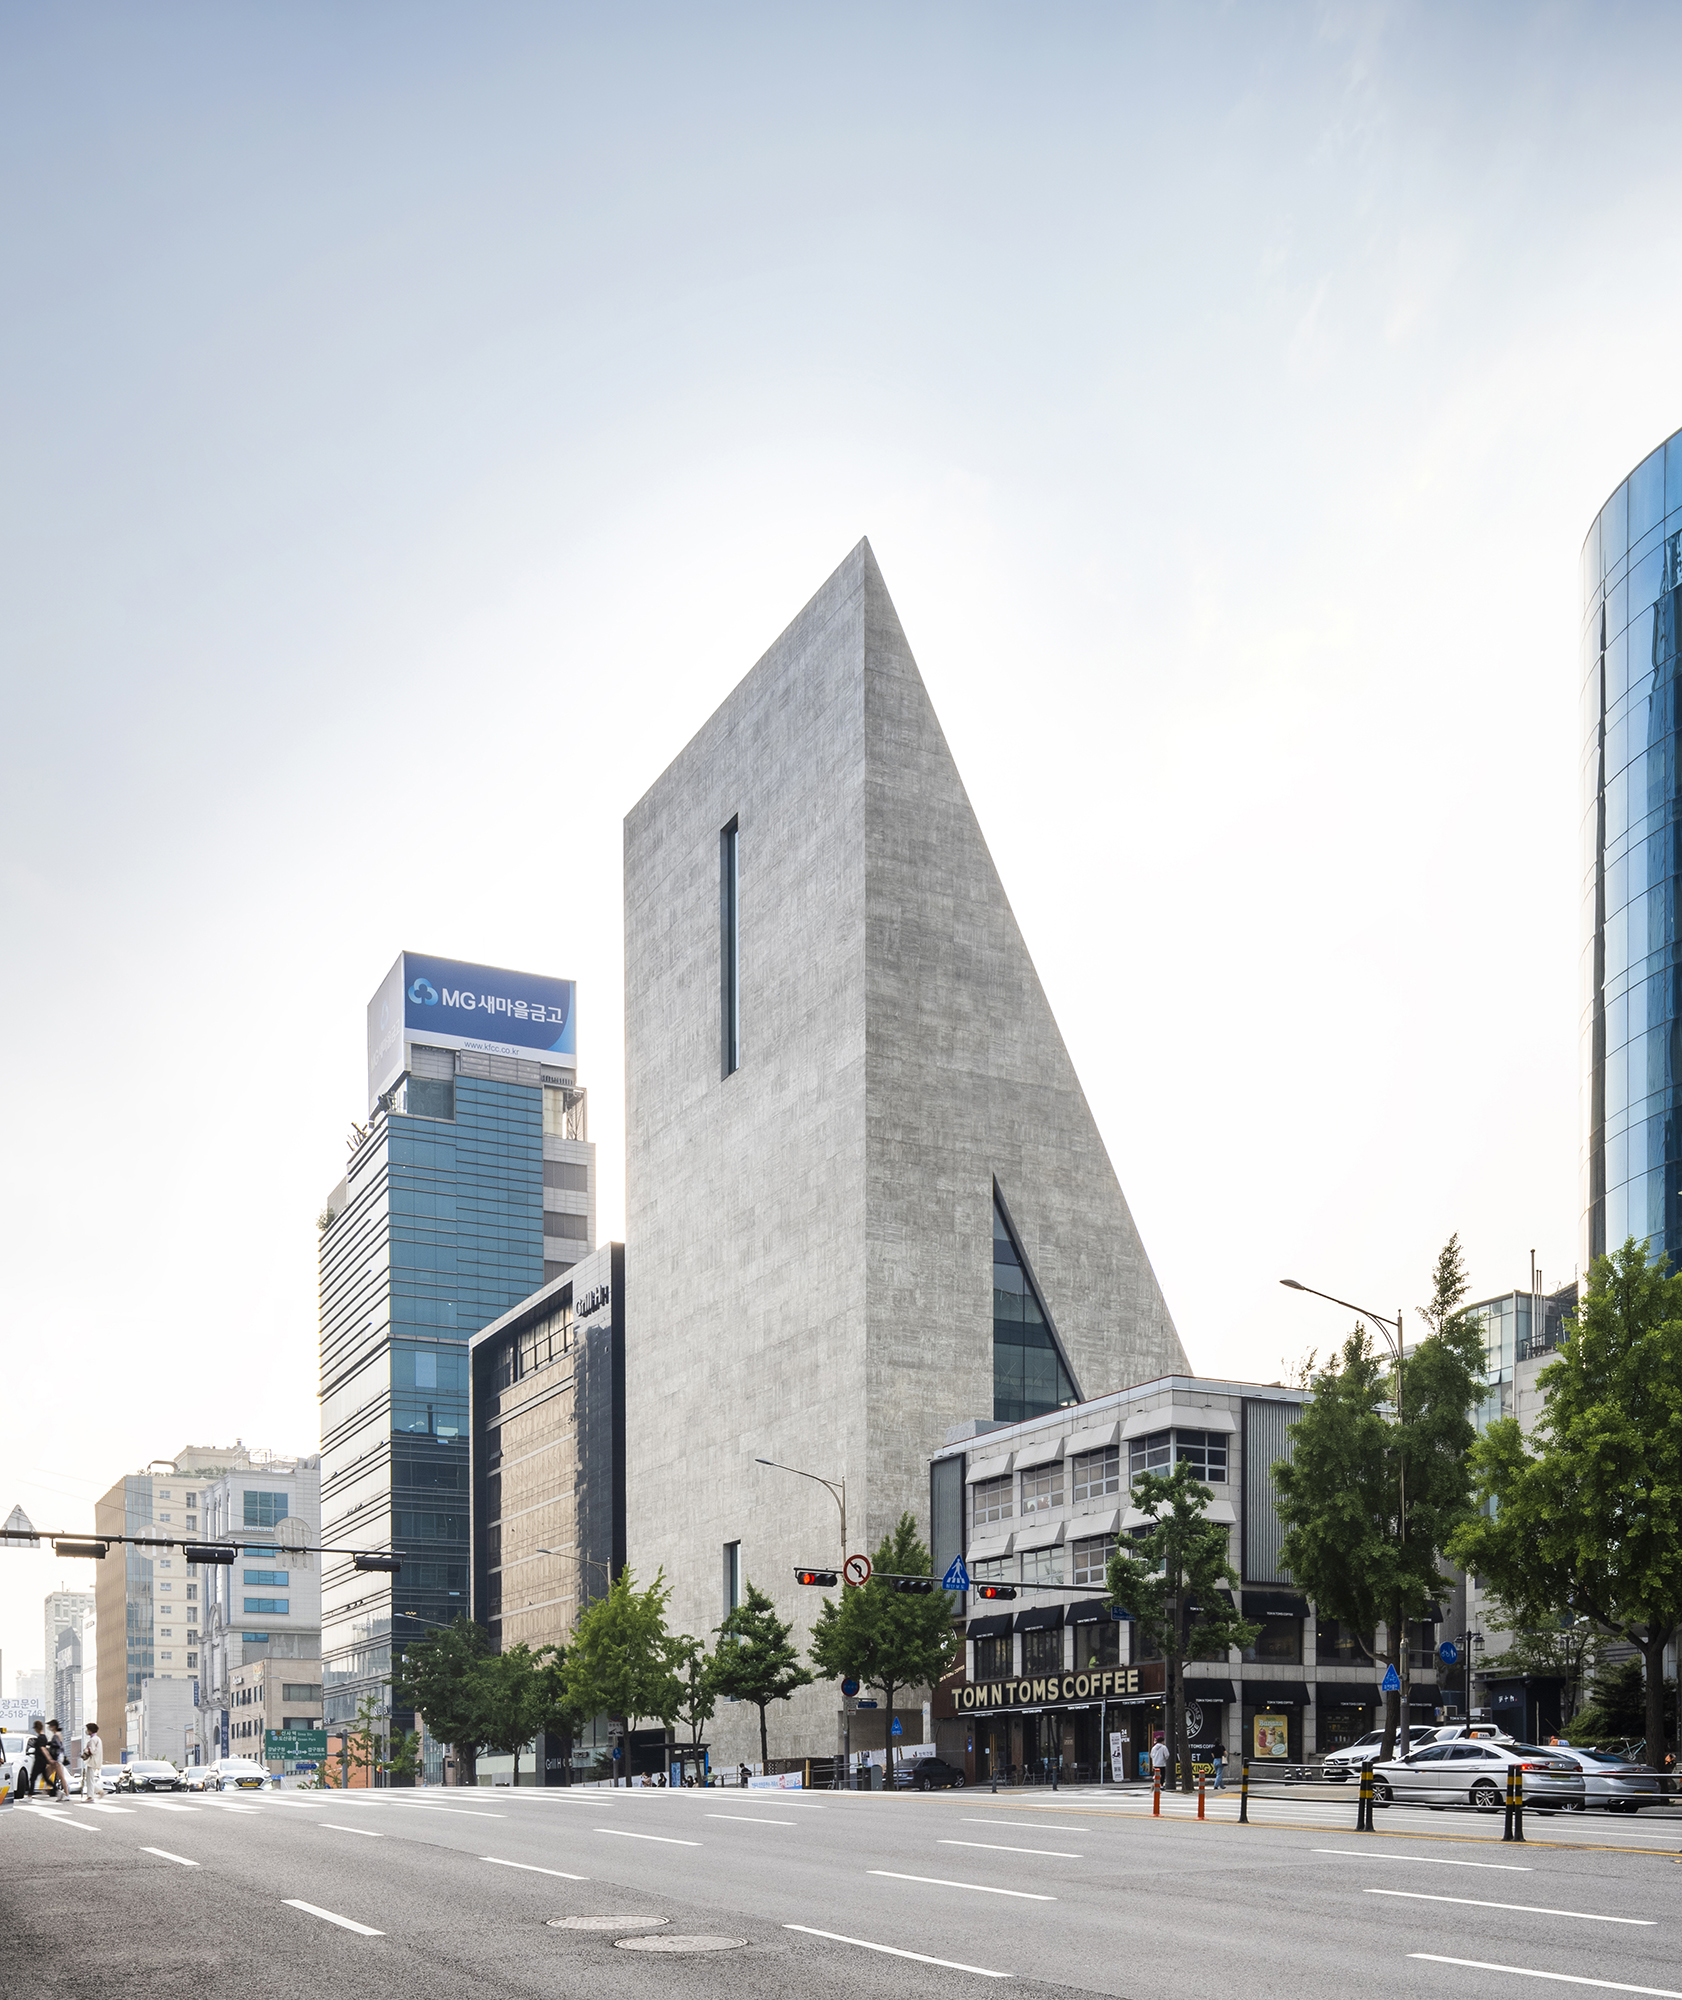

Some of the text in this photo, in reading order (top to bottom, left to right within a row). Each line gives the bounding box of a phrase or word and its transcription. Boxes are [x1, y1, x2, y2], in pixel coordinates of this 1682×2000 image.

[464, 1041, 520, 1055] www.kfcc.co.kr
[952, 1669, 1139, 1709] TOM N TOMS COFFEE
[2, 1698, 39, 1709] 광고문의
